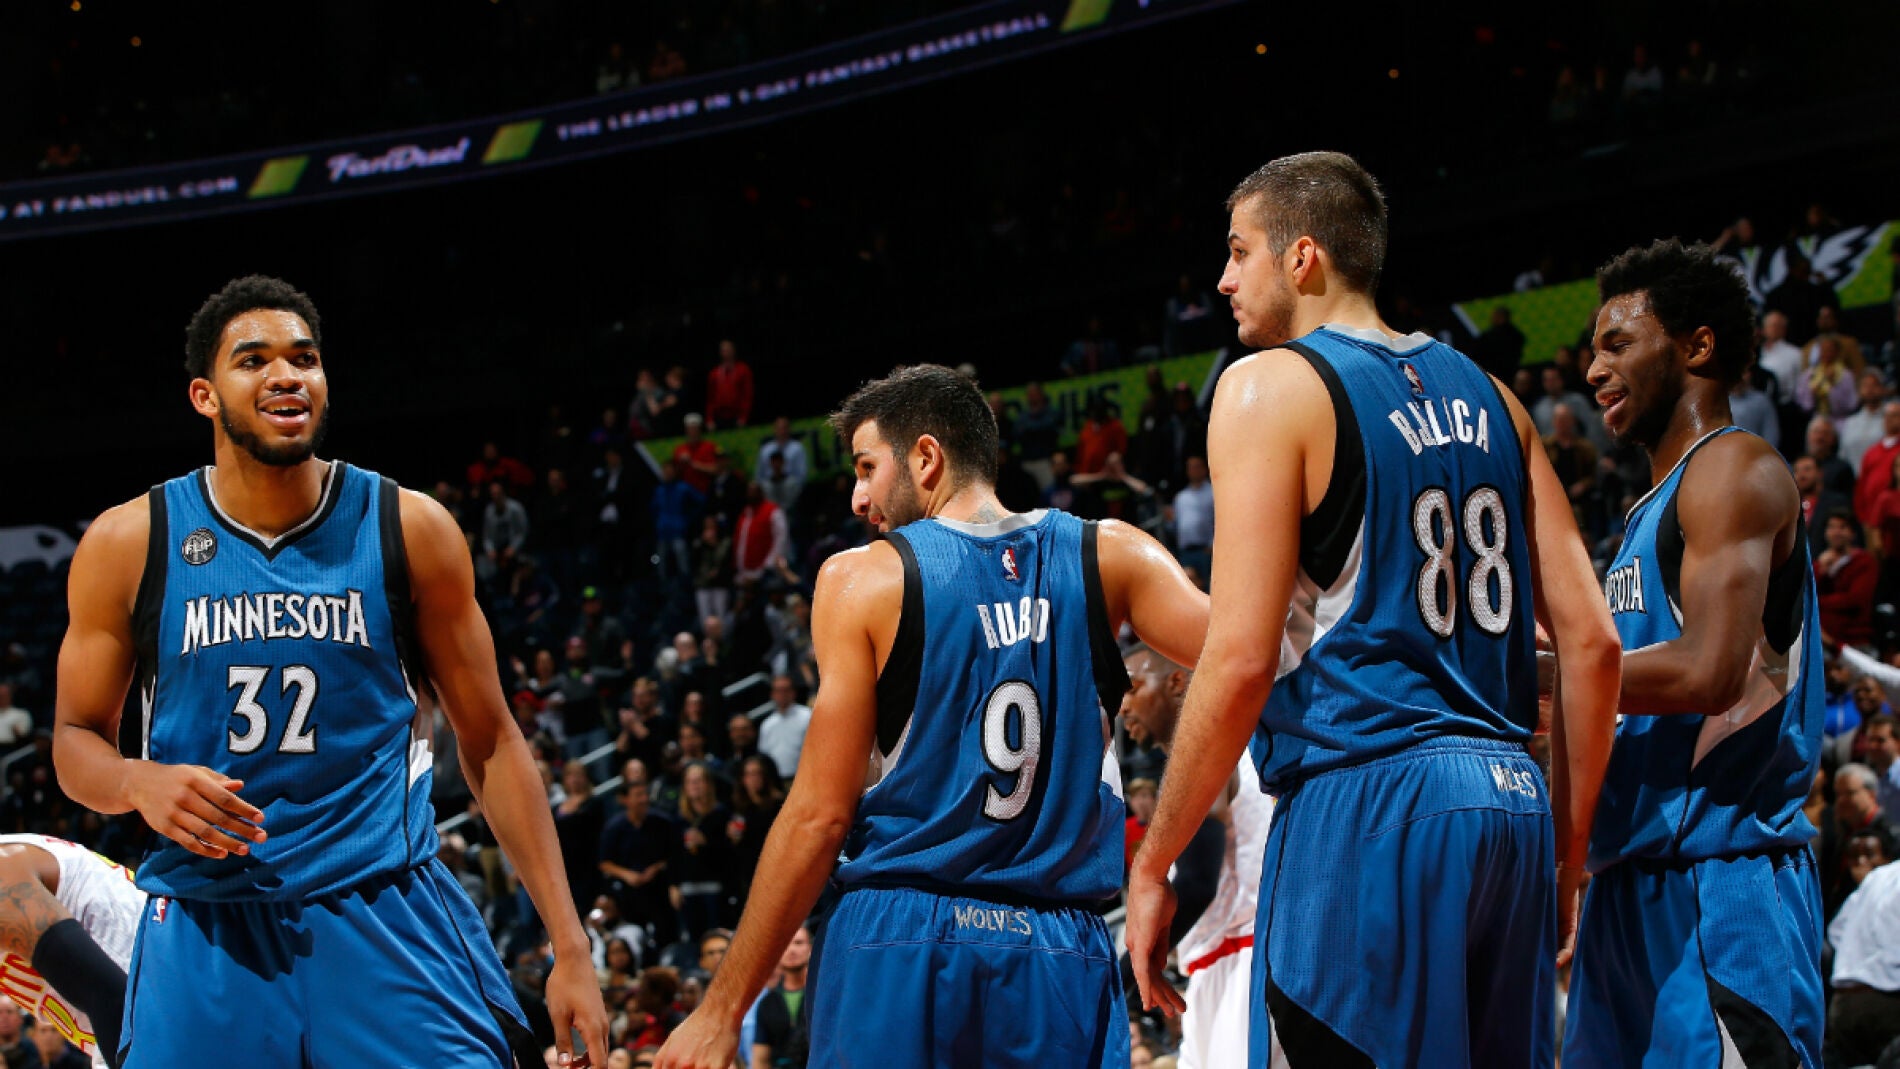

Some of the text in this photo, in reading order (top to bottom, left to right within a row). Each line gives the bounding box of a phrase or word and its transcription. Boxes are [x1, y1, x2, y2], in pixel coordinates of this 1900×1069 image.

[557, 119, 600, 142] THE
[804, 50, 902, 88] FANTASY
[906, 12, 1049, 62] BASKETBALL
[327, 136, 471, 183] FanDuel
[185, 538, 213, 554] FLIP
[1411, 484, 1514, 638] 88
[180, 588, 372, 658] MINNESOTA
[226, 663, 318, 756] 32
[979, 679, 1043, 823] 9
[953, 904, 1032, 937] WOLVES
